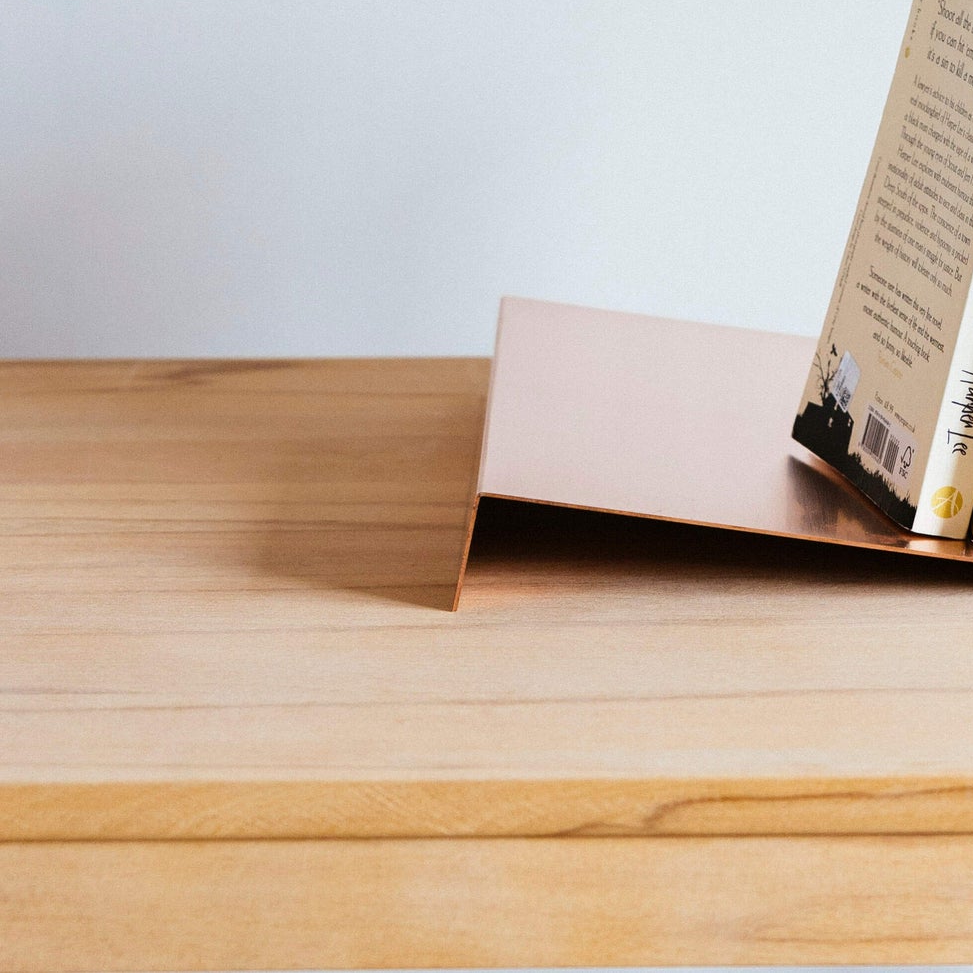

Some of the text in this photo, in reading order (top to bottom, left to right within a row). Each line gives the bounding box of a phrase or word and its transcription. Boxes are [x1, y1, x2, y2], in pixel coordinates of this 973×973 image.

[955, 10, 965, 26] all
[963, 14, 972, 32] the
[934, 30, 947, 43] you
[946, 36, 958, 49] can
[957, 35, 965, 54] hit
[935, 56, 941, 65] a
[940, 56, 949, 70] sin
[949, 62, 956, 74] to
[956, 60, 965, 79] kill
[963, 72, 969, 82] a
[898, 467, 909, 480] FSC
